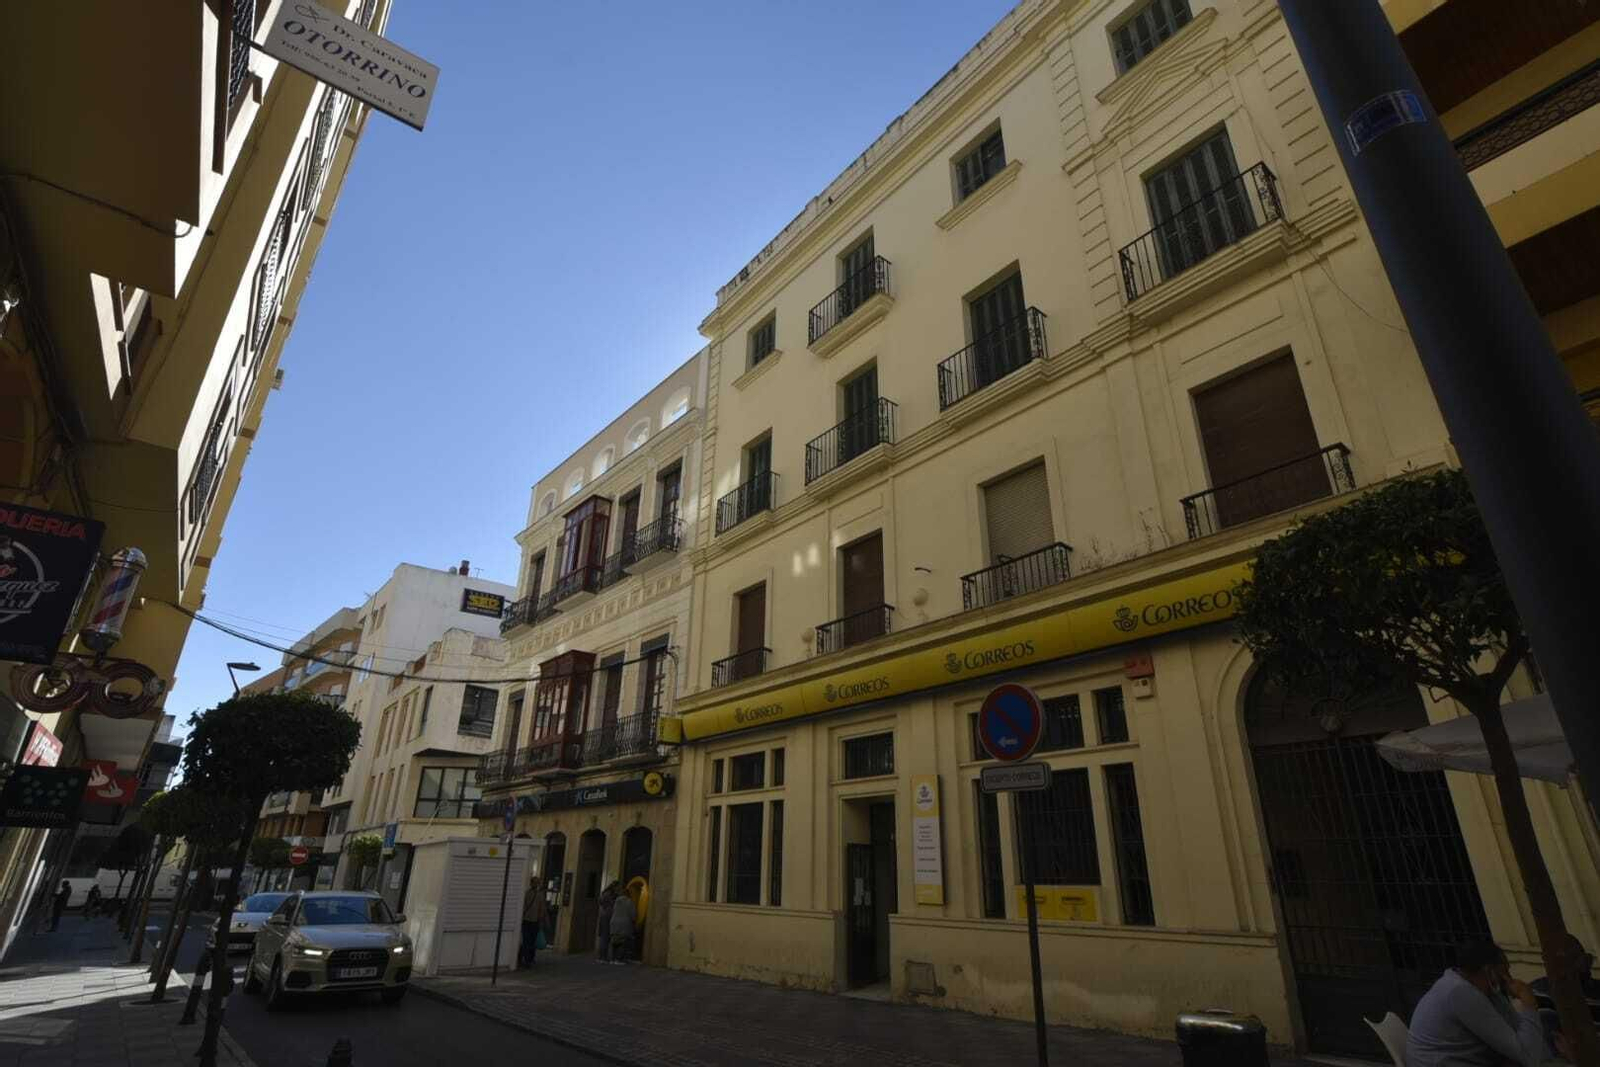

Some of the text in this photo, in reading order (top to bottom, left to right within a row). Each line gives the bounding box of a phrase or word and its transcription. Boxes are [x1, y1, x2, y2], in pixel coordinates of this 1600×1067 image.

[283, 20, 427, 98] OTORRINO
[1142, 588, 1240, 627] CORREO
[964, 639, 1035, 671] CORREOS
[838, 676, 890, 700] CORREOS
[745, 703, 783, 722] CORREOS
